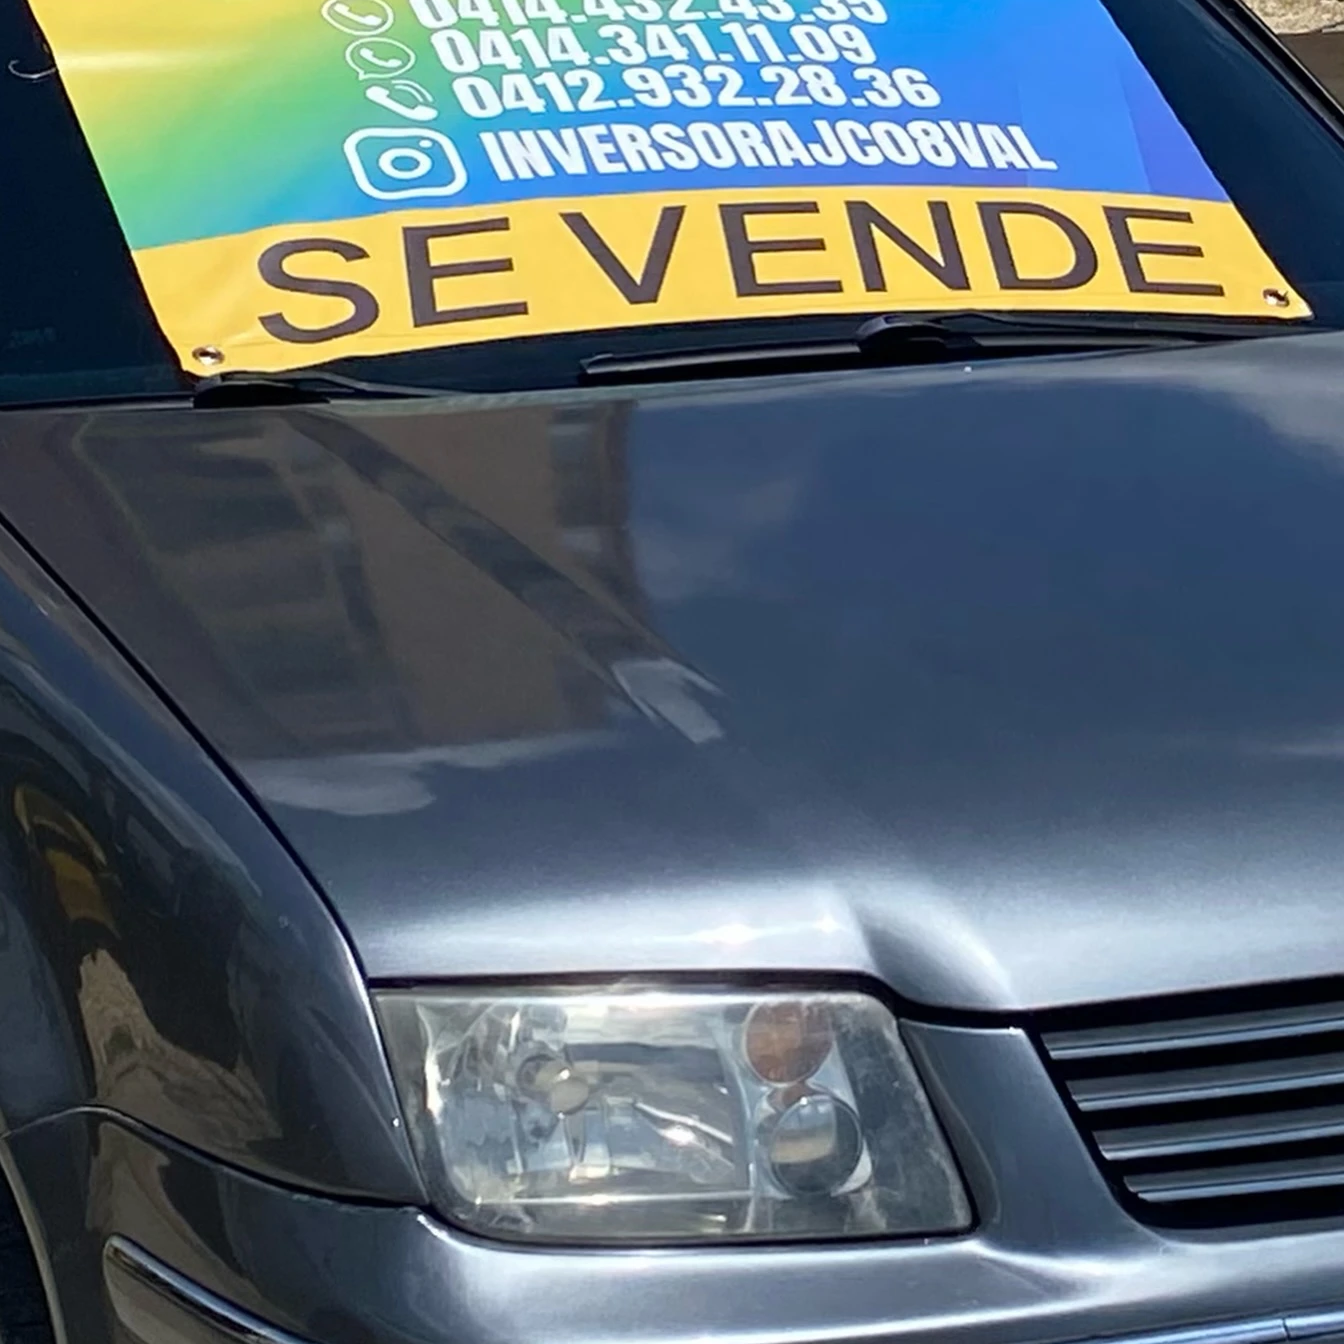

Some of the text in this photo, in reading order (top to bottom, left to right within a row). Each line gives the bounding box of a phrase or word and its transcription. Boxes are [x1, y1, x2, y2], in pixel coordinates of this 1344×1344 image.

[429, 23, 876, 74] 0414.341.11.09
[452, 64, 942, 119] 0412.932.28.36
[256, 199, 1225, 344] SE VENDE
